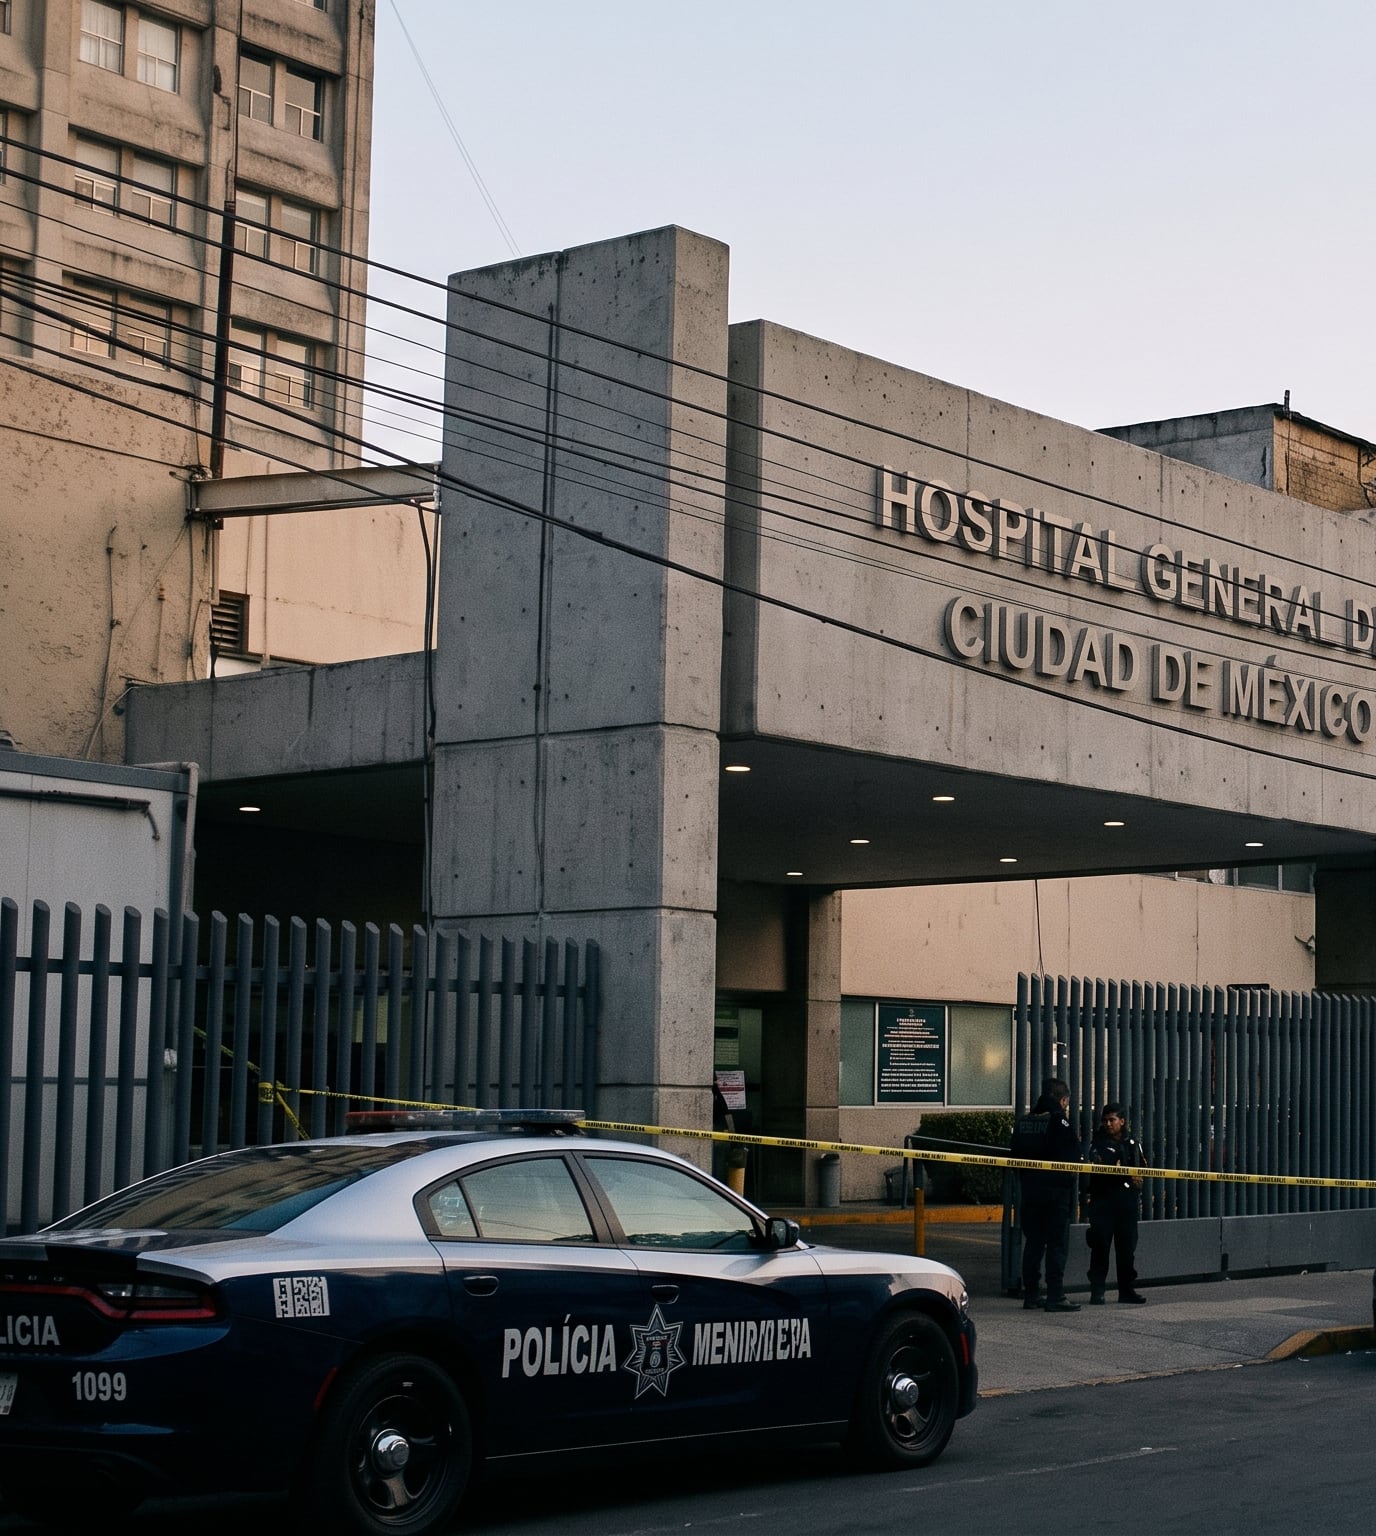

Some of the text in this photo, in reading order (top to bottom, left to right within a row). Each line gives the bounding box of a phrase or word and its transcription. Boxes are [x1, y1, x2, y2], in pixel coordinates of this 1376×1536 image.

[876, 464, 1137, 592] HOSPITAL
[1140, 543, 1335, 646] GENERAL
[944, 596, 1372, 742] CIUDAD DE MÉXICO
[72, 1371, 127, 1401] 1099
[501, 1314, 617, 1378] POLÍCIA
